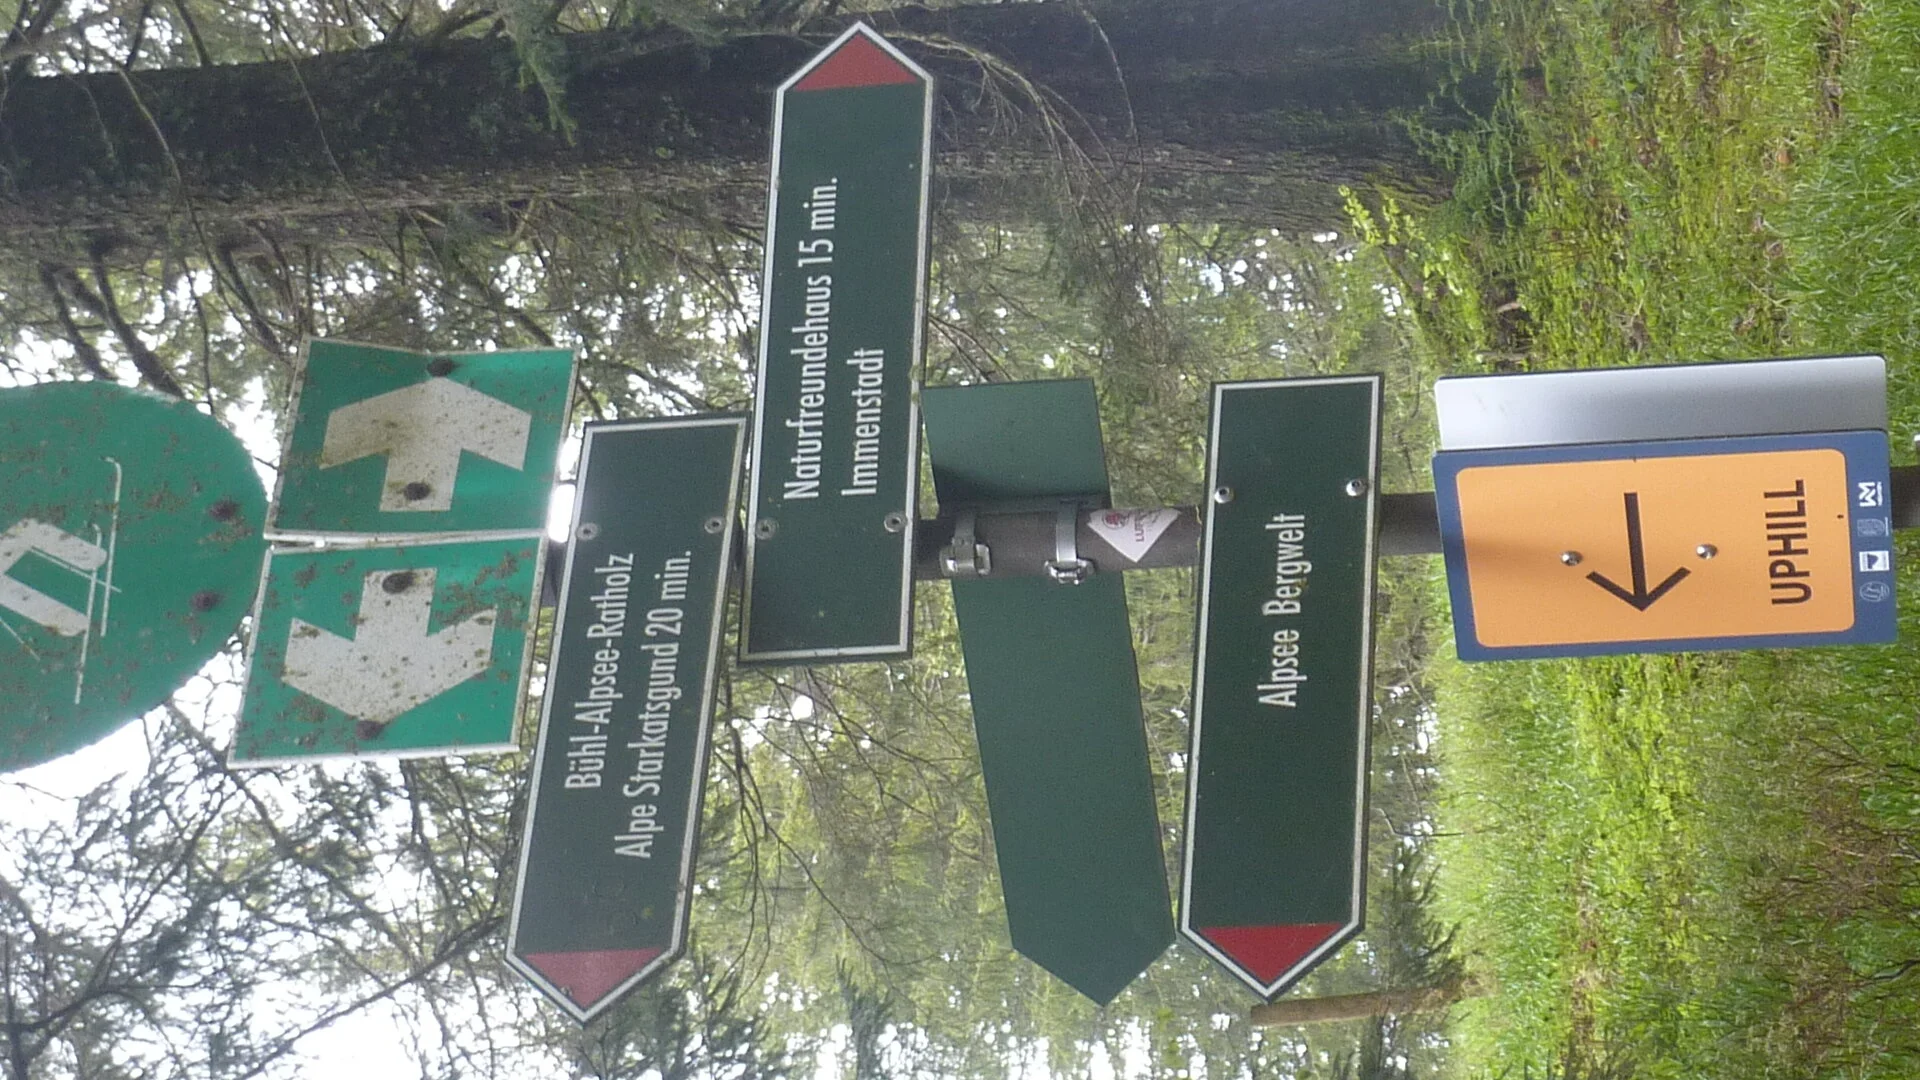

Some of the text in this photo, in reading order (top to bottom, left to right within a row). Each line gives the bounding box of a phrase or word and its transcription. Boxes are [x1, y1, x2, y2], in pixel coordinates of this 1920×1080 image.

[784, 177, 838, 499] Naturfreundehaus 15 min.
[841, 347, 884, 496] Immenstadt
[1257, 513, 1312, 707] Alpsee Bergwelt
[1763, 479, 1812, 605] UPHILL
[565, 552, 634, 790] Bühl-Alpsee-Ratholz
[614, 550, 692, 859] Alpe Starkatsgund 20 min.
